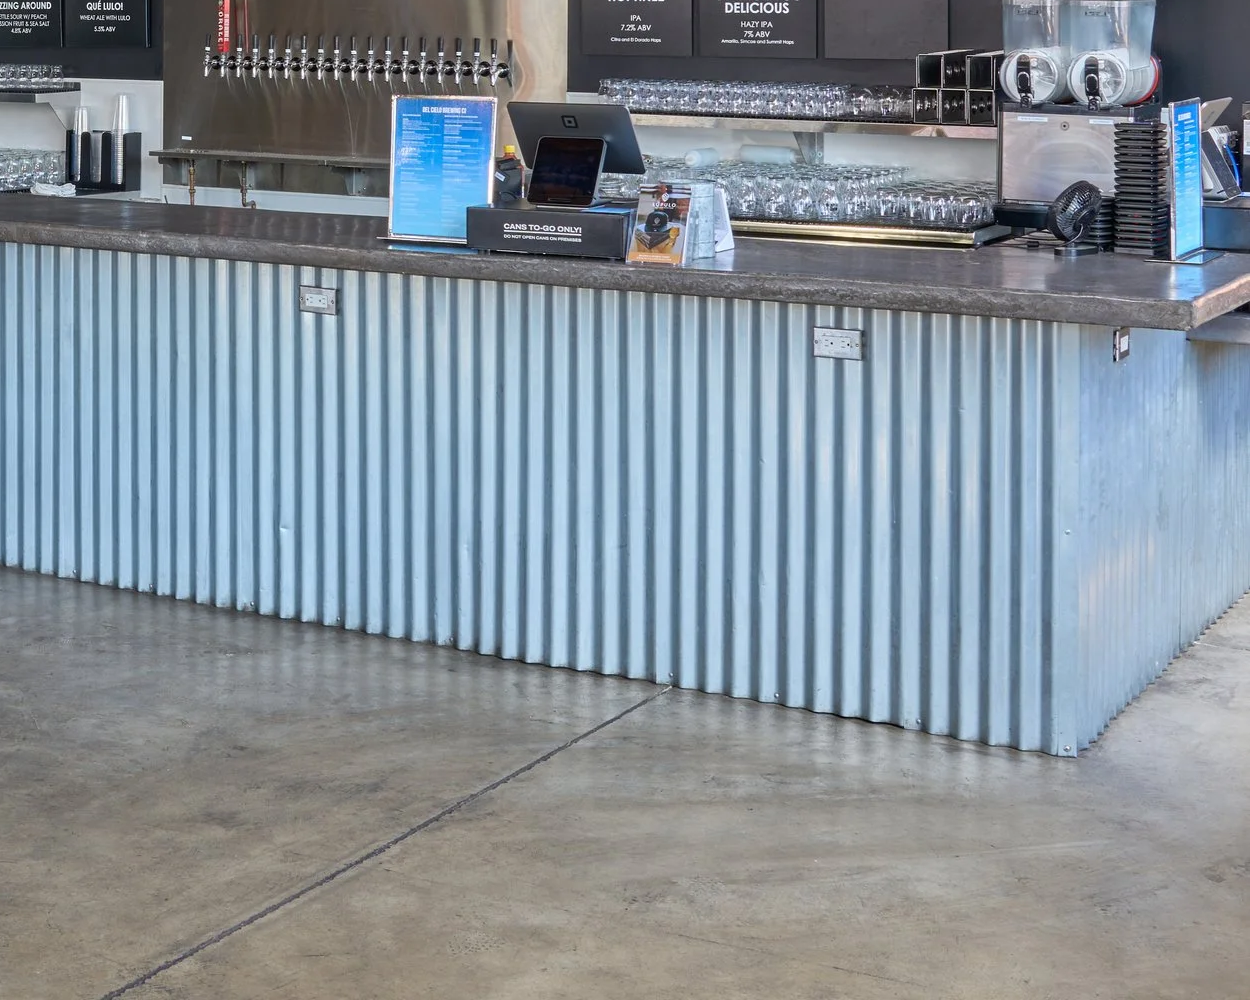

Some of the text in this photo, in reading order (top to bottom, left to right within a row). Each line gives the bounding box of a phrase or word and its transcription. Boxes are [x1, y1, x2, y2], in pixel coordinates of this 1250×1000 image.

[20, 1, 52, 10] AROUND
[86, 0, 123, 10] QUÉ LULO!
[724, 2, 790, 14] DELICIOUS
[528, 224, 556, 232] TO-GO
